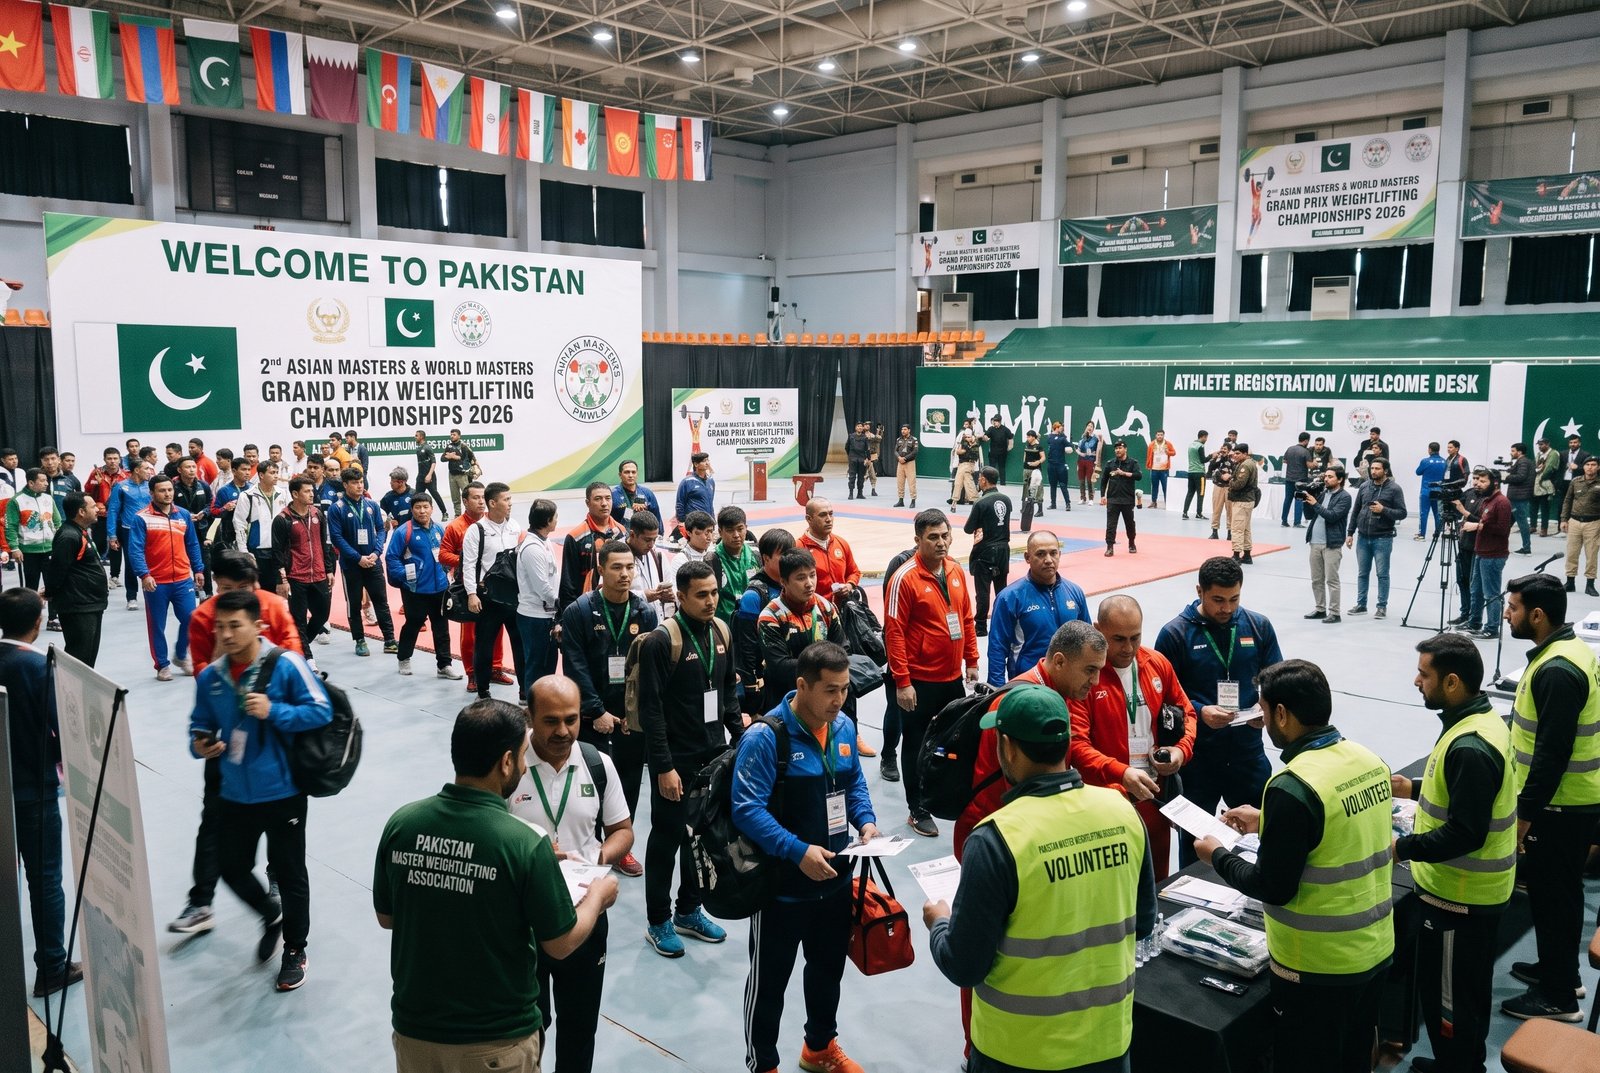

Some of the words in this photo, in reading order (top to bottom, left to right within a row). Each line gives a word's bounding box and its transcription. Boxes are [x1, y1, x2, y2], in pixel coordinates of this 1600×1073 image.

[1280, 187, 1301, 196] ASIAN
[1304, 183, 1340, 194] MASTERS
[1342, 182, 1347, 190] &
[1350, 180, 1378, 190] WORLD
[1381, 175, 1419, 187] MASTERS
[1266, 199, 1300, 212] GRAND
[1304, 196, 1328, 208] PRIX
[1332, 188, 1418, 206] WEIGHTLIFTING
[1559, 202, 1590, 212] MASTERS
[1278, 208, 1371, 226] CHAMPIONSHIPS
[1375, 205, 1405, 219] 2026
[161, 239, 369, 283] WELCOME
[381, 256, 427, 286] TO
[439, 259, 584, 296] PAKISTAN
[939, 256, 958, 264] GRAND
[975, 252, 1021, 261] WEIGHTLIFTING
[946, 262, 994, 272] CHAMPIONSHIPS
[260, 357, 281, 375] 2nd
[287, 359, 332, 375] ASIAN
[338, 359, 406, 375] MASTERS
[411, 360, 420, 375] &
[425, 360, 472, 376] WORLD
[476, 361, 534, 376] MASTERS
[261, 380, 335, 402] GRAND
[343, 381, 389, 401] PRIX
[396, 380, 534, 400] WEIGHTLIFTING
[1174, 373, 1230, 391] ATHLETE
[1234, 373, 1336, 392] REGISTRATION
[1339, 373, 1347, 393] /
[1350, 374, 1430, 393] WELCOME
[1435, 374, 1479, 394] DESK
[290, 405, 463, 429] CHAMPIONSHIPS
[469, 404, 514, 424] 2026
[572, 407, 607, 420] PMWLA
[707, 429, 729, 437] GRAND
[731, 429, 746, 437] PRIX
[747, 428, 794, 436] WEIGHTLIFTING
[716, 437, 769, 446] CHAMPIONSHIPS
[1341, 780, 1391, 818] VOLUNTEER
[415, 834, 474, 859] PAKISTAN
[391, 850, 424, 868] MASTER
[426, 855, 498, 881] WEIGHTLIFTING
[1044, 842, 1129, 883] VOLUNTEER
[407, 869, 474, 895] ASSOCIATION
